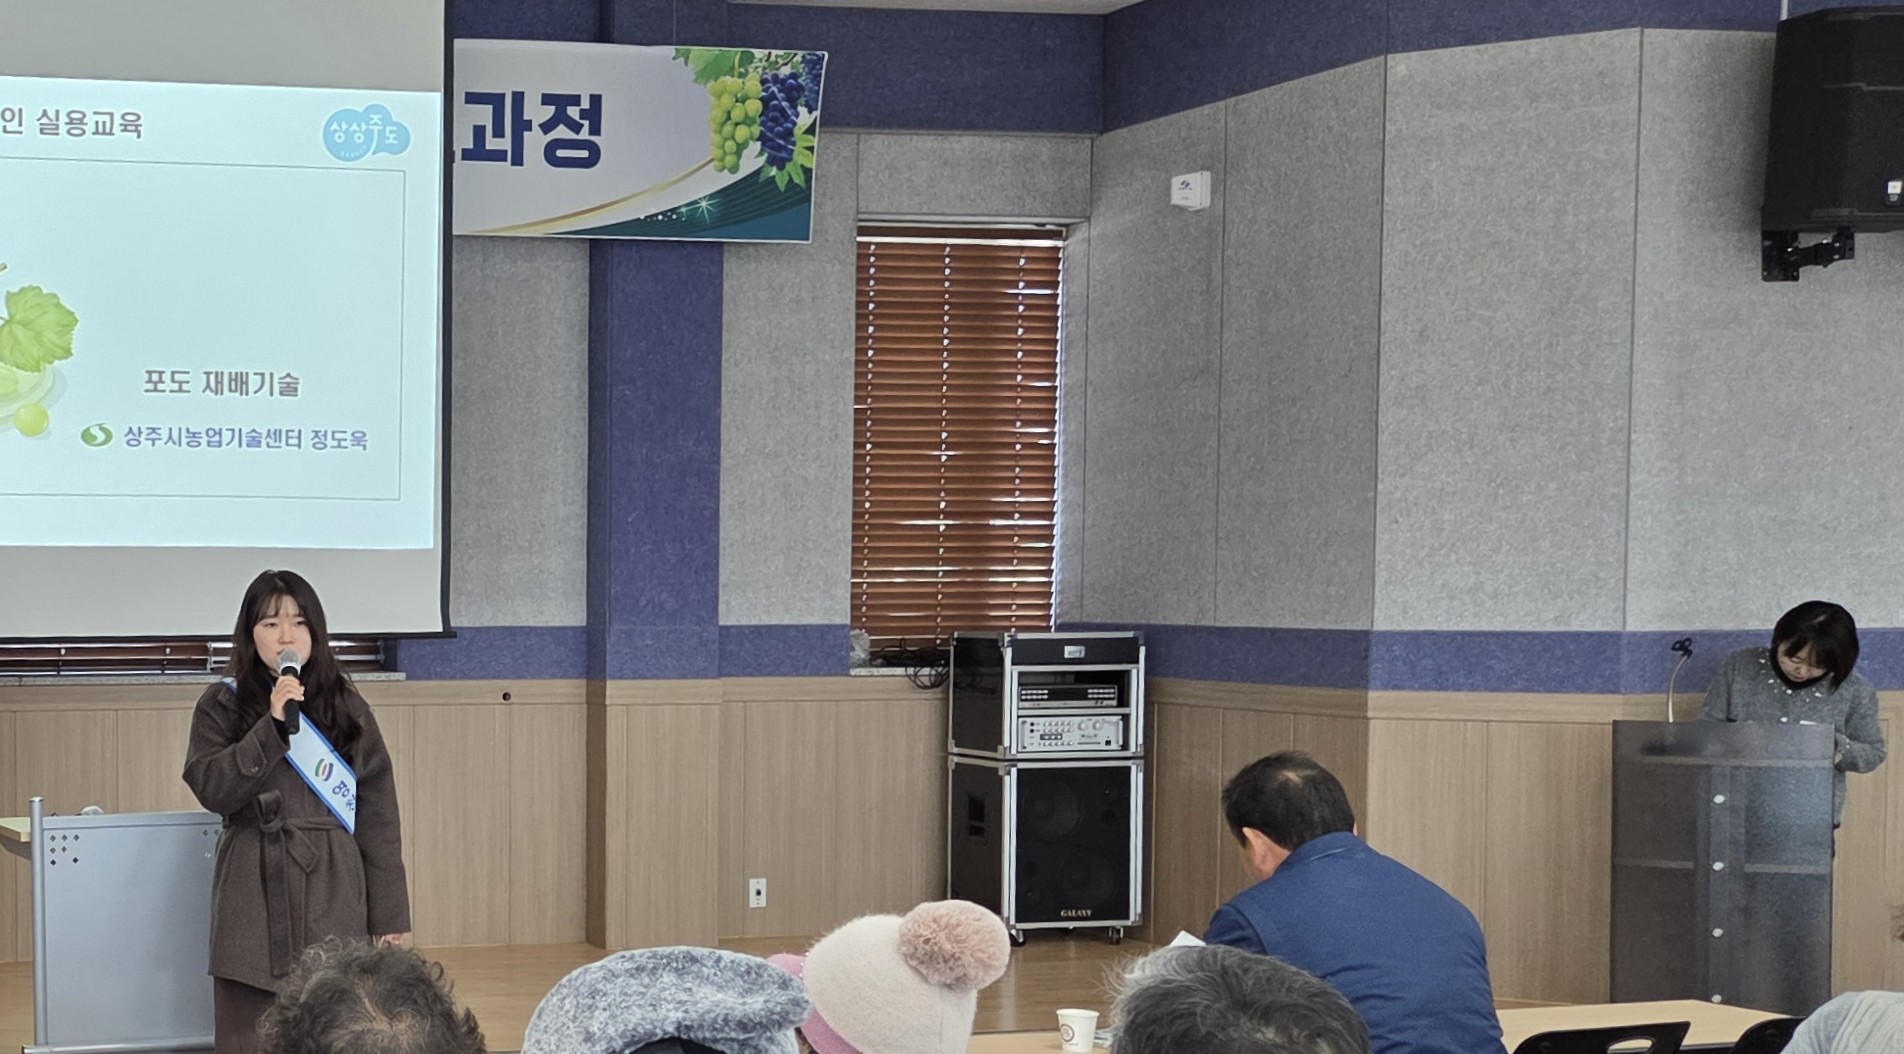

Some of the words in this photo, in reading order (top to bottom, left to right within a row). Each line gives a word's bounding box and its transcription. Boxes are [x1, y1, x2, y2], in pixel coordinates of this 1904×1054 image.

[36, 108, 143, 140] 실용교육
[453, 90, 603, 170] 과정
[143, 370, 192, 394] 포도
[201, 370, 301, 397] 재배기술
[123, 425, 303, 450] 상주시농업기술센터
[310, 429, 369, 451] 정도욱
